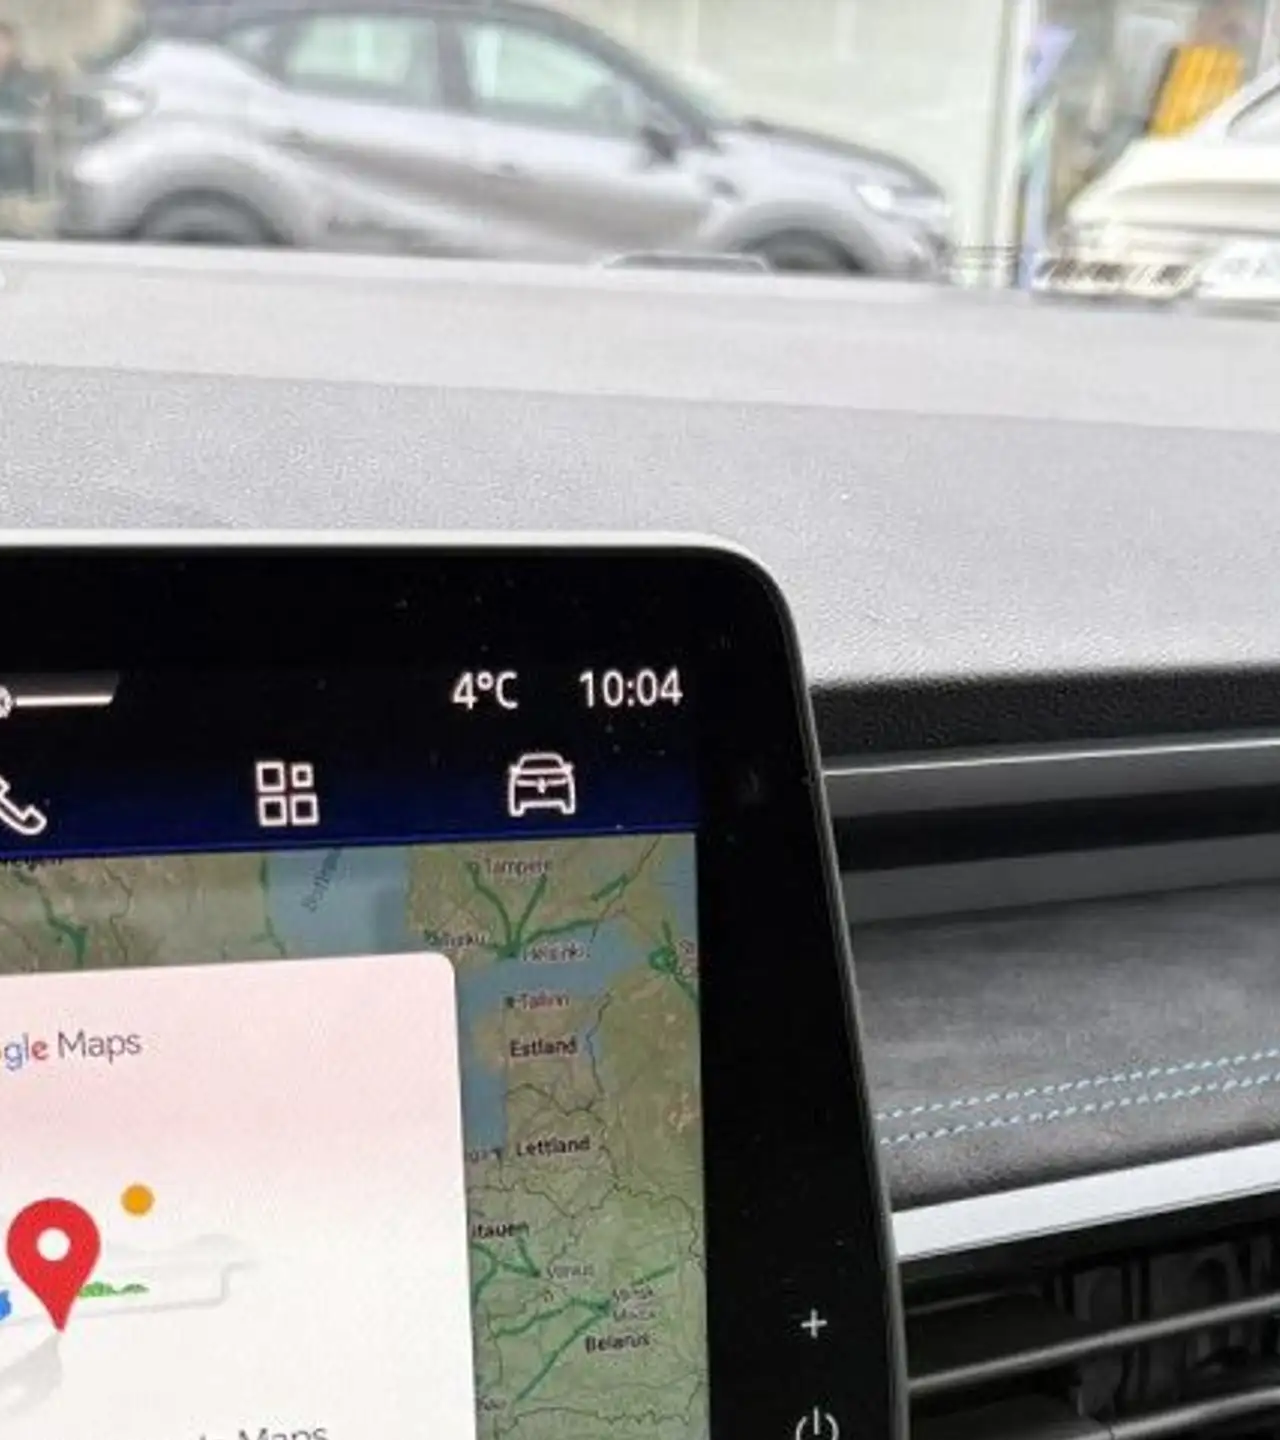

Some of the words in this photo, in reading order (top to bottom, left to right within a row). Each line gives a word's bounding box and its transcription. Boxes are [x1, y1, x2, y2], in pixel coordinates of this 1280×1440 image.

[452, 670, 520, 710] 4°C
[579, 669, 684, 708] 10:04
[56, 1029, 142, 1062] Maps
[510, 1036, 577, 1057] Estland
[516, 1135, 591, 1157] Lettland
